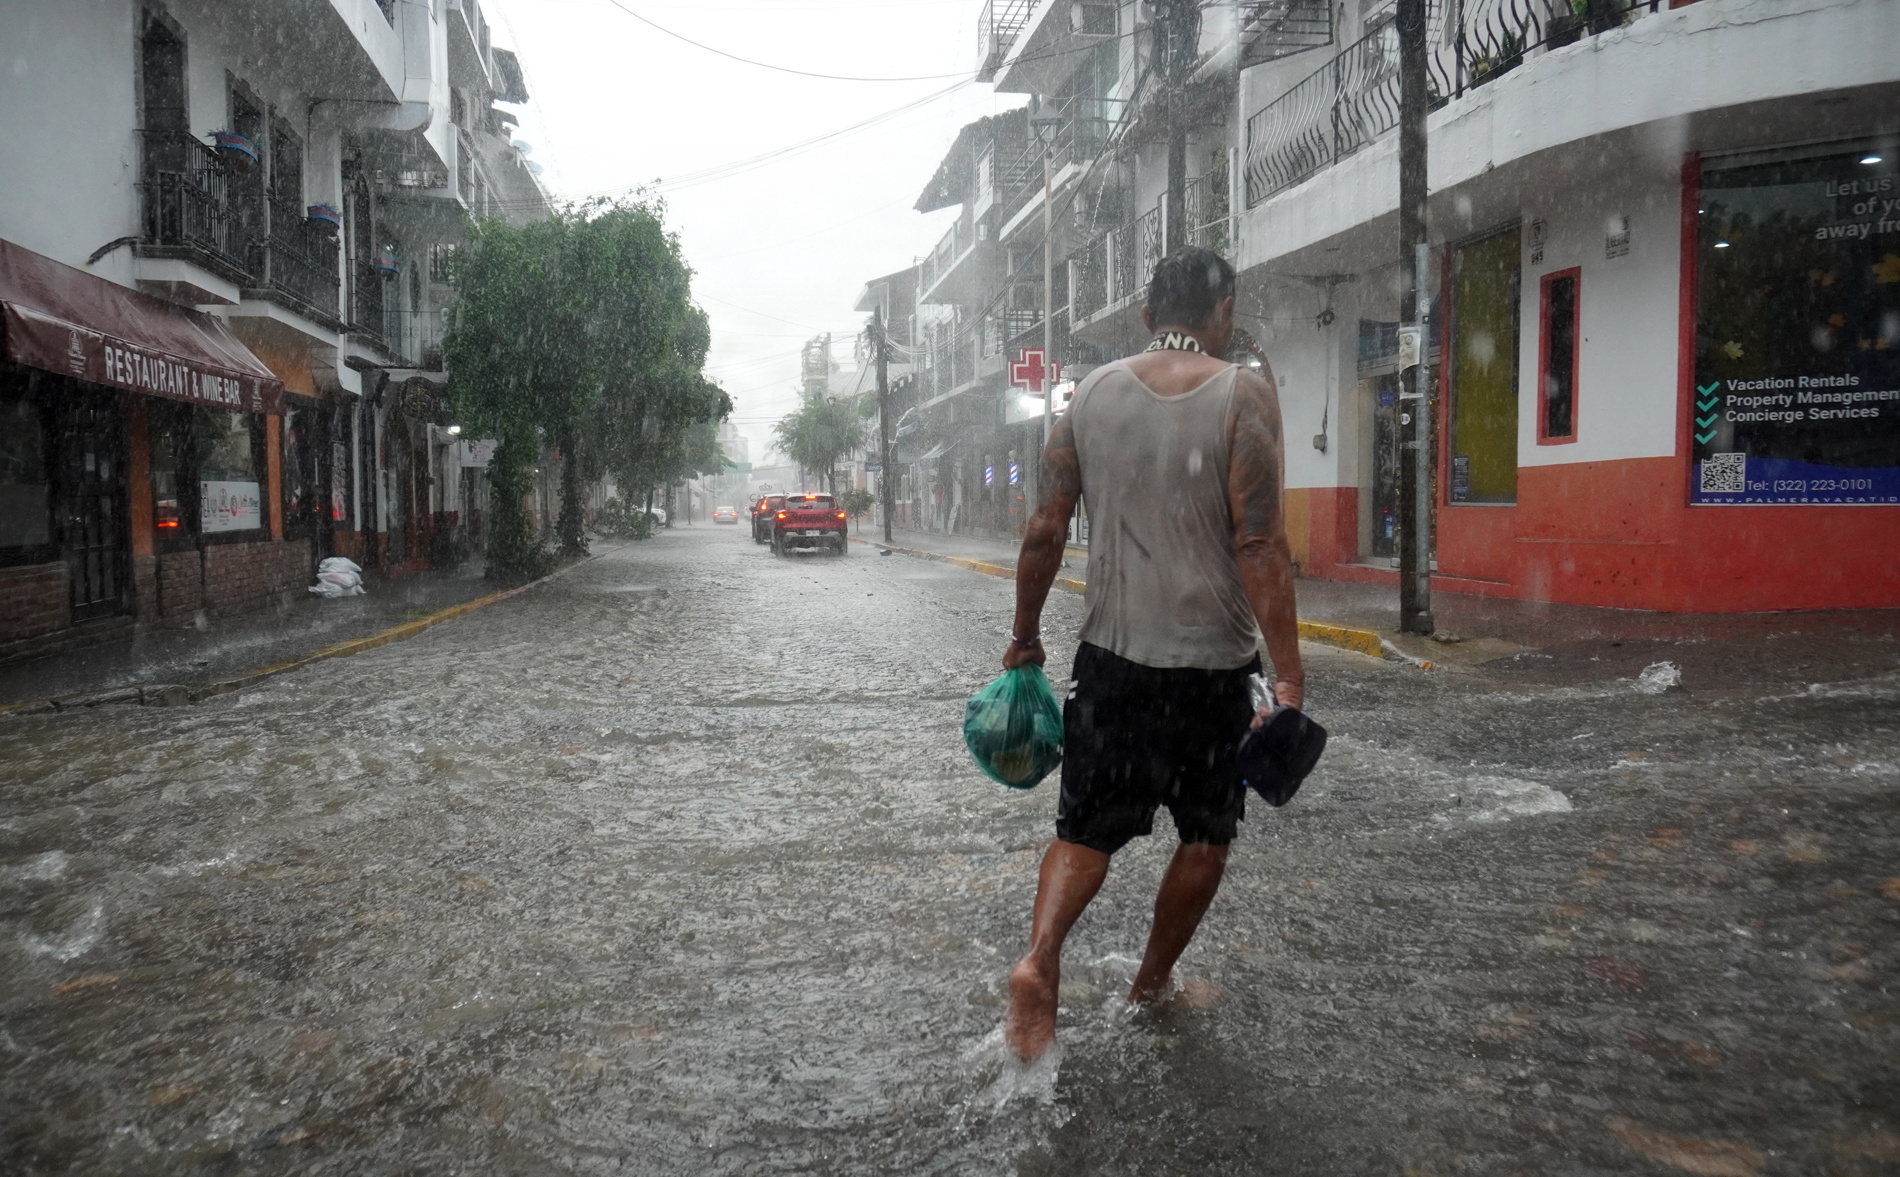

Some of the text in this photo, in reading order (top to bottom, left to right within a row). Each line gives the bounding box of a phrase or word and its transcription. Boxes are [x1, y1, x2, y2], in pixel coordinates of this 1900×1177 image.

[1825, 178, 1892, 198] Let us
[1853, 197, 1877, 215] of
[1816, 222, 1872, 240] away
[105, 345, 189, 396] RESTAURANT
[192, 371, 200, 398] &
[201, 373, 223, 402] WINE
[224, 378, 241, 405] BAR
[1726, 373, 1860, 391] Vacation Rentals
[1726, 389, 1900, 408] Property Managemen
[1725, 406, 1880, 423] Concierge Services
[1746, 478, 1872, 493] Tel: (322) 223-0101
